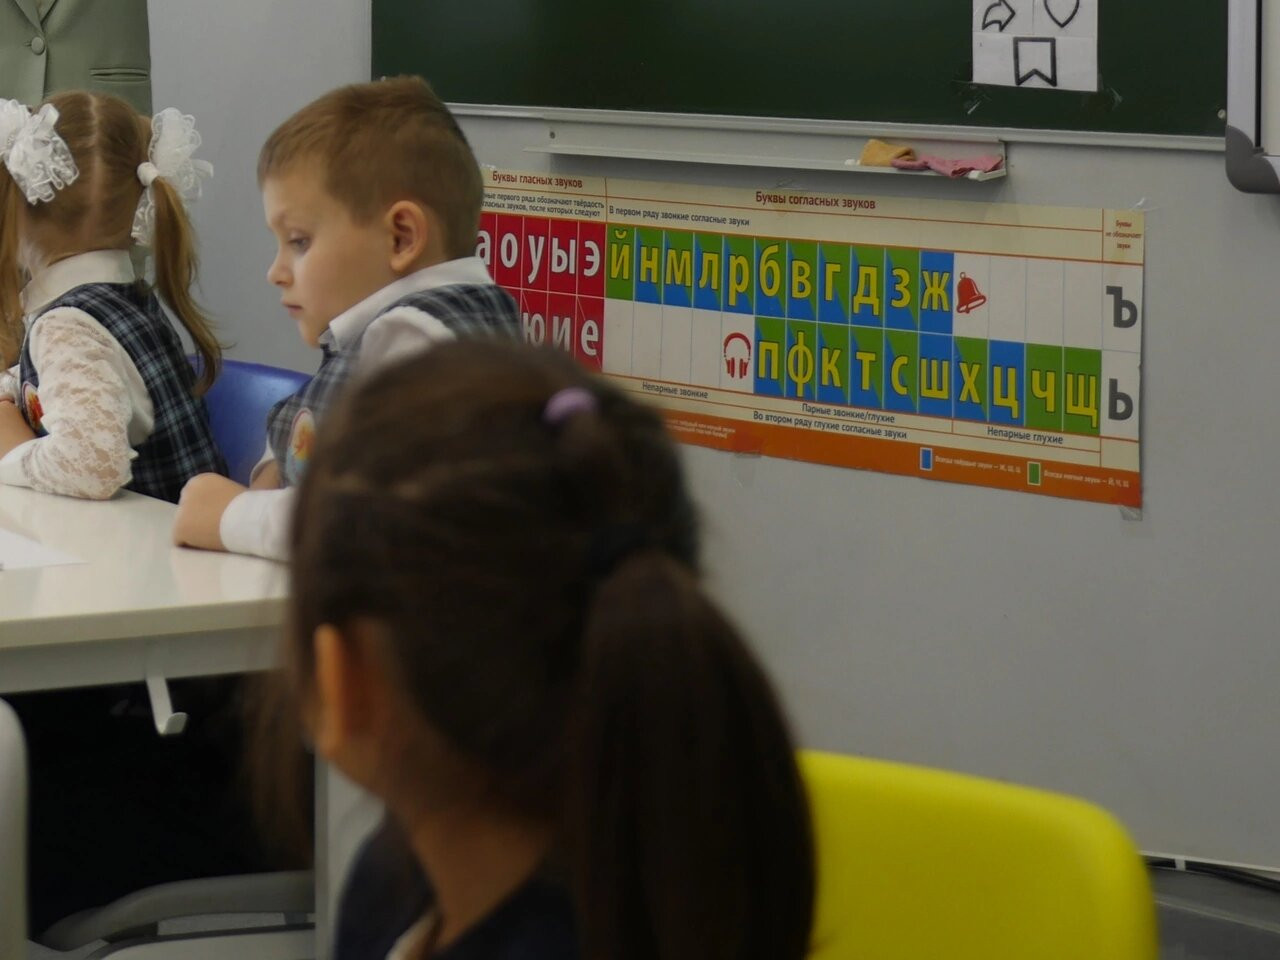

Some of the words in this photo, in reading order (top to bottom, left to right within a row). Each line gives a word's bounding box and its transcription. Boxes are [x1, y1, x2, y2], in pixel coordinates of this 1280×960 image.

[492, 170, 518, 184] Буквы
[520, 174, 553, 187] гласных
[554, 177, 583, 190] звуков
[497, 193, 521, 203] первого
[522, 195, 536, 204] ряда
[537, 196, 573, 207] обозначают
[573, 197, 605, 209] твёрдость
[506, 202, 528, 211] звуков,
[528, 204, 546, 212] после
[547, 207, 574, 215] которых
[574, 208, 601, 218] следуют
[755, 191, 786, 205] Буквы
[789, 195, 839, 208] согласных
[842, 198, 876, 212] звуков
[609, 205, 614, 215] В
[615, 207, 642, 220] первом
[642, 209, 659, 222] ряду
[659, 211, 690, 222] звонкие
[690, 213, 728, 226] согласные
[728, 215, 751, 228] звуки
[475, 229, 491, 266] а
[500, 231, 518, 268] о
[527, 234, 545, 284] у
[551, 236, 576, 275] ы
[583, 239, 600, 277] э
[610, 229, 630, 280] й
[639, 245, 659, 284] н
[665, 247, 692, 288] м
[698, 250, 720, 291] л
[727, 253, 750, 307] р
[758, 241, 781, 297] б
[790, 259, 812, 300] в
[824, 261, 841, 302] г
[852, 265, 880, 316] д
[890, 268, 912, 309] з
[920, 269, 951, 312] ж
[522, 311, 545, 348] ю
[552, 314, 570, 352] и
[581, 318, 599, 357] е
[758, 340, 780, 380] п
[786, 330, 814, 398] ф
[821, 347, 843, 388] к
[856, 350, 877, 391] т
[890, 354, 909, 396] с
[920, 357, 949, 400] ш
[958, 361, 982, 404] х
[992, 365, 1019, 420] ц
[1030, 369, 1056, 413] ч
[1065, 373, 1099, 428] щ
[642, 381, 678, 396] Непарные
[679, 386, 709, 399] звонкие
[802, 403, 831, 418] Парные
[832, 406, 896, 424] звонкие/глухие
[753, 410, 764, 421] Во
[765, 413, 793, 426] втором
[793, 416, 813, 429] ряду
[814, 419, 841, 433] глухие
[842, 422, 883, 437] согласные
[883, 425, 908, 440] звуки
[987, 426, 1031, 441] Непарные
[1033, 432, 1064, 446] глухие
